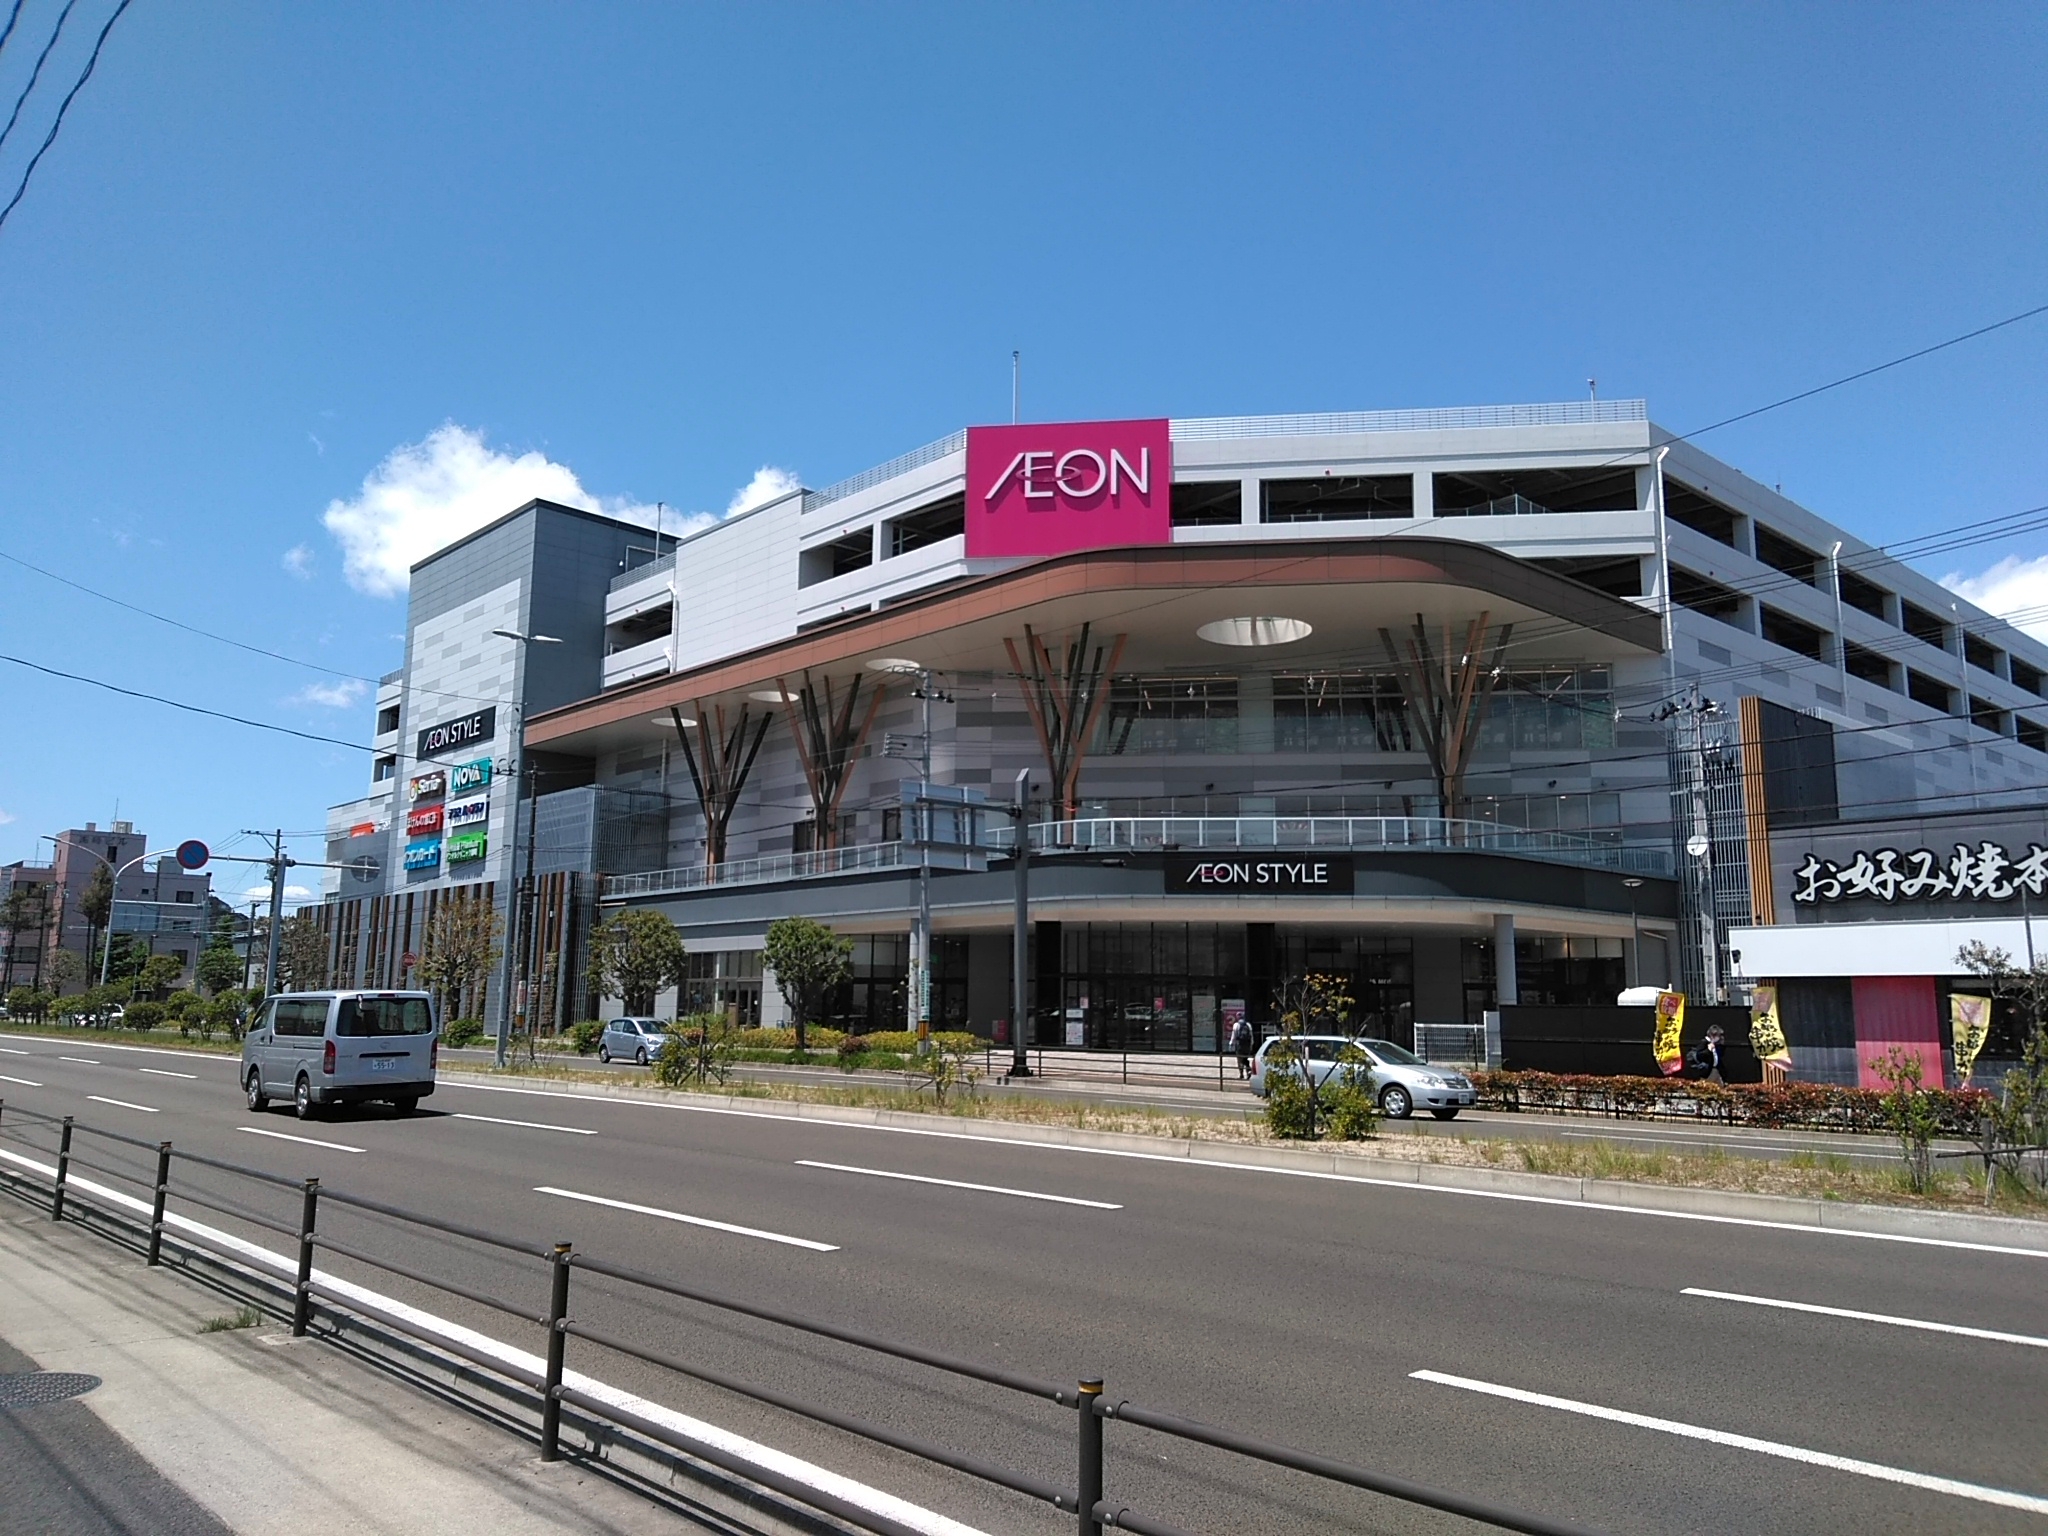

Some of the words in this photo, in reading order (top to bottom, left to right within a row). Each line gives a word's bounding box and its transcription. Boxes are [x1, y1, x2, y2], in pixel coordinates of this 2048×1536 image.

[450, 716, 481, 743] STYLE
[453, 763, 481, 787] NOVA
[1256, 863, 1328, 883] STYLE
